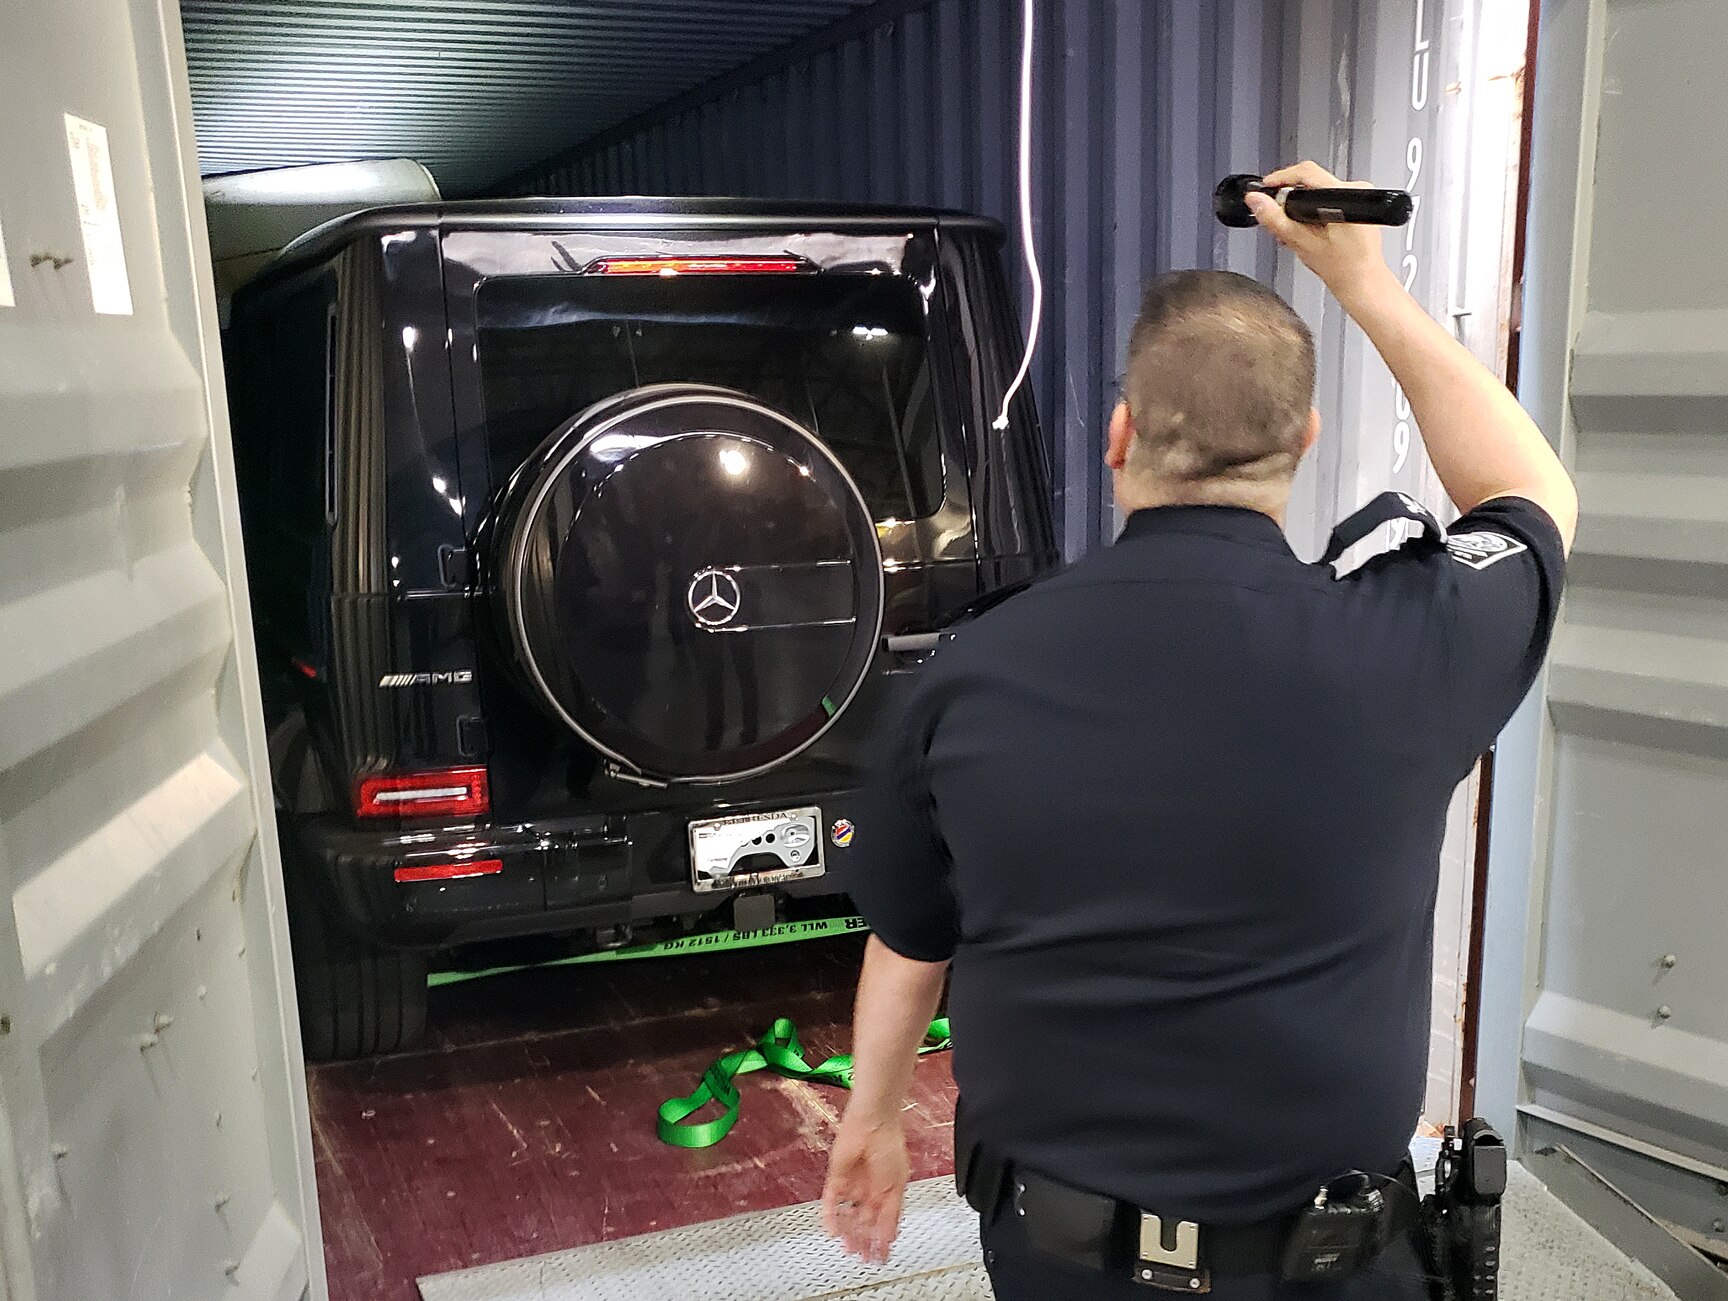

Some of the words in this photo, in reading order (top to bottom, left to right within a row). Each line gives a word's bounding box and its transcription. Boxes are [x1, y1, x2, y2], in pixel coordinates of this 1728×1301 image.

[414, 669, 472, 686] AMG
[762, 924, 797, 937] 3,333
[801, 921, 828, 932] WLL
[689, 935, 719, 947] 1512
[733, 930, 758, 941] LBS
[664, 940, 685, 950] KG
